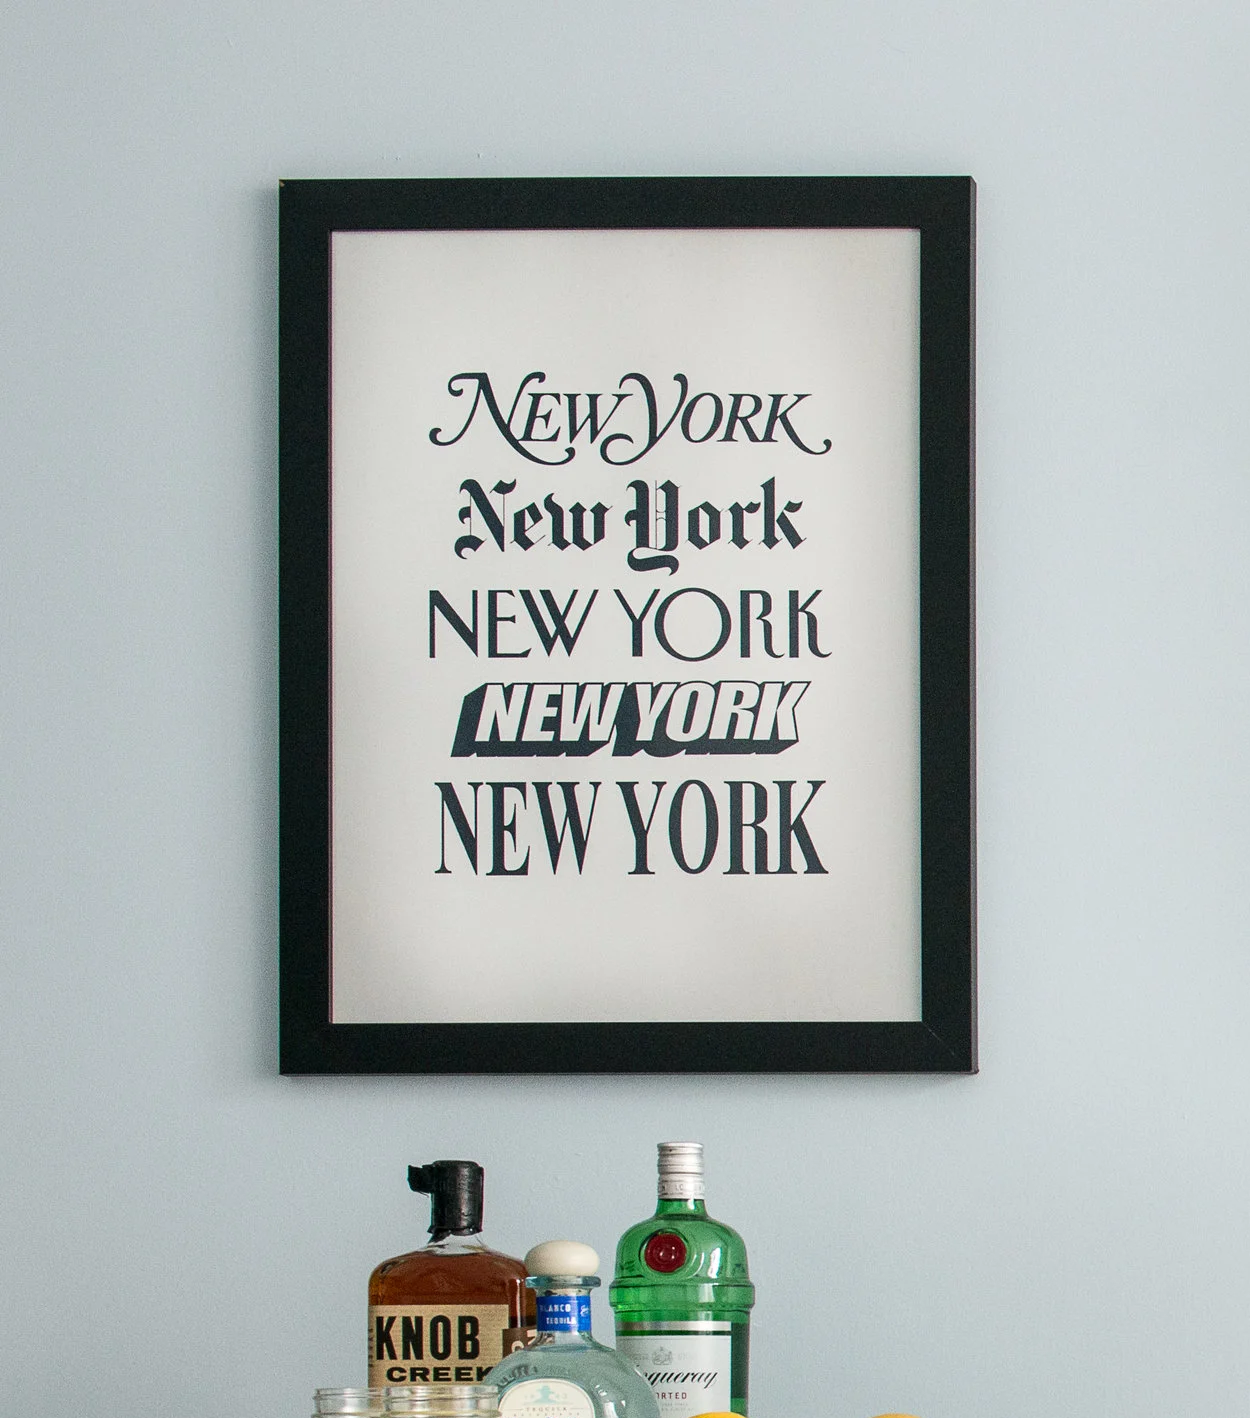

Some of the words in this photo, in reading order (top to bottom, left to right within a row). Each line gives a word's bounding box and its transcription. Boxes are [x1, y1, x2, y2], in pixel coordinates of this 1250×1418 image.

[454, 477, 613, 560] New
[623, 475, 807, 577] York
[428, 588, 599, 659] NEW
[613, 587, 832, 662] YORK
[452, 681, 629, 757] NEW
[611, 680, 812, 757] YORK
[433, 780, 602, 876] NEW
[615, 778, 830, 876] YORK
[375, 1314, 480, 1361] KNOB
